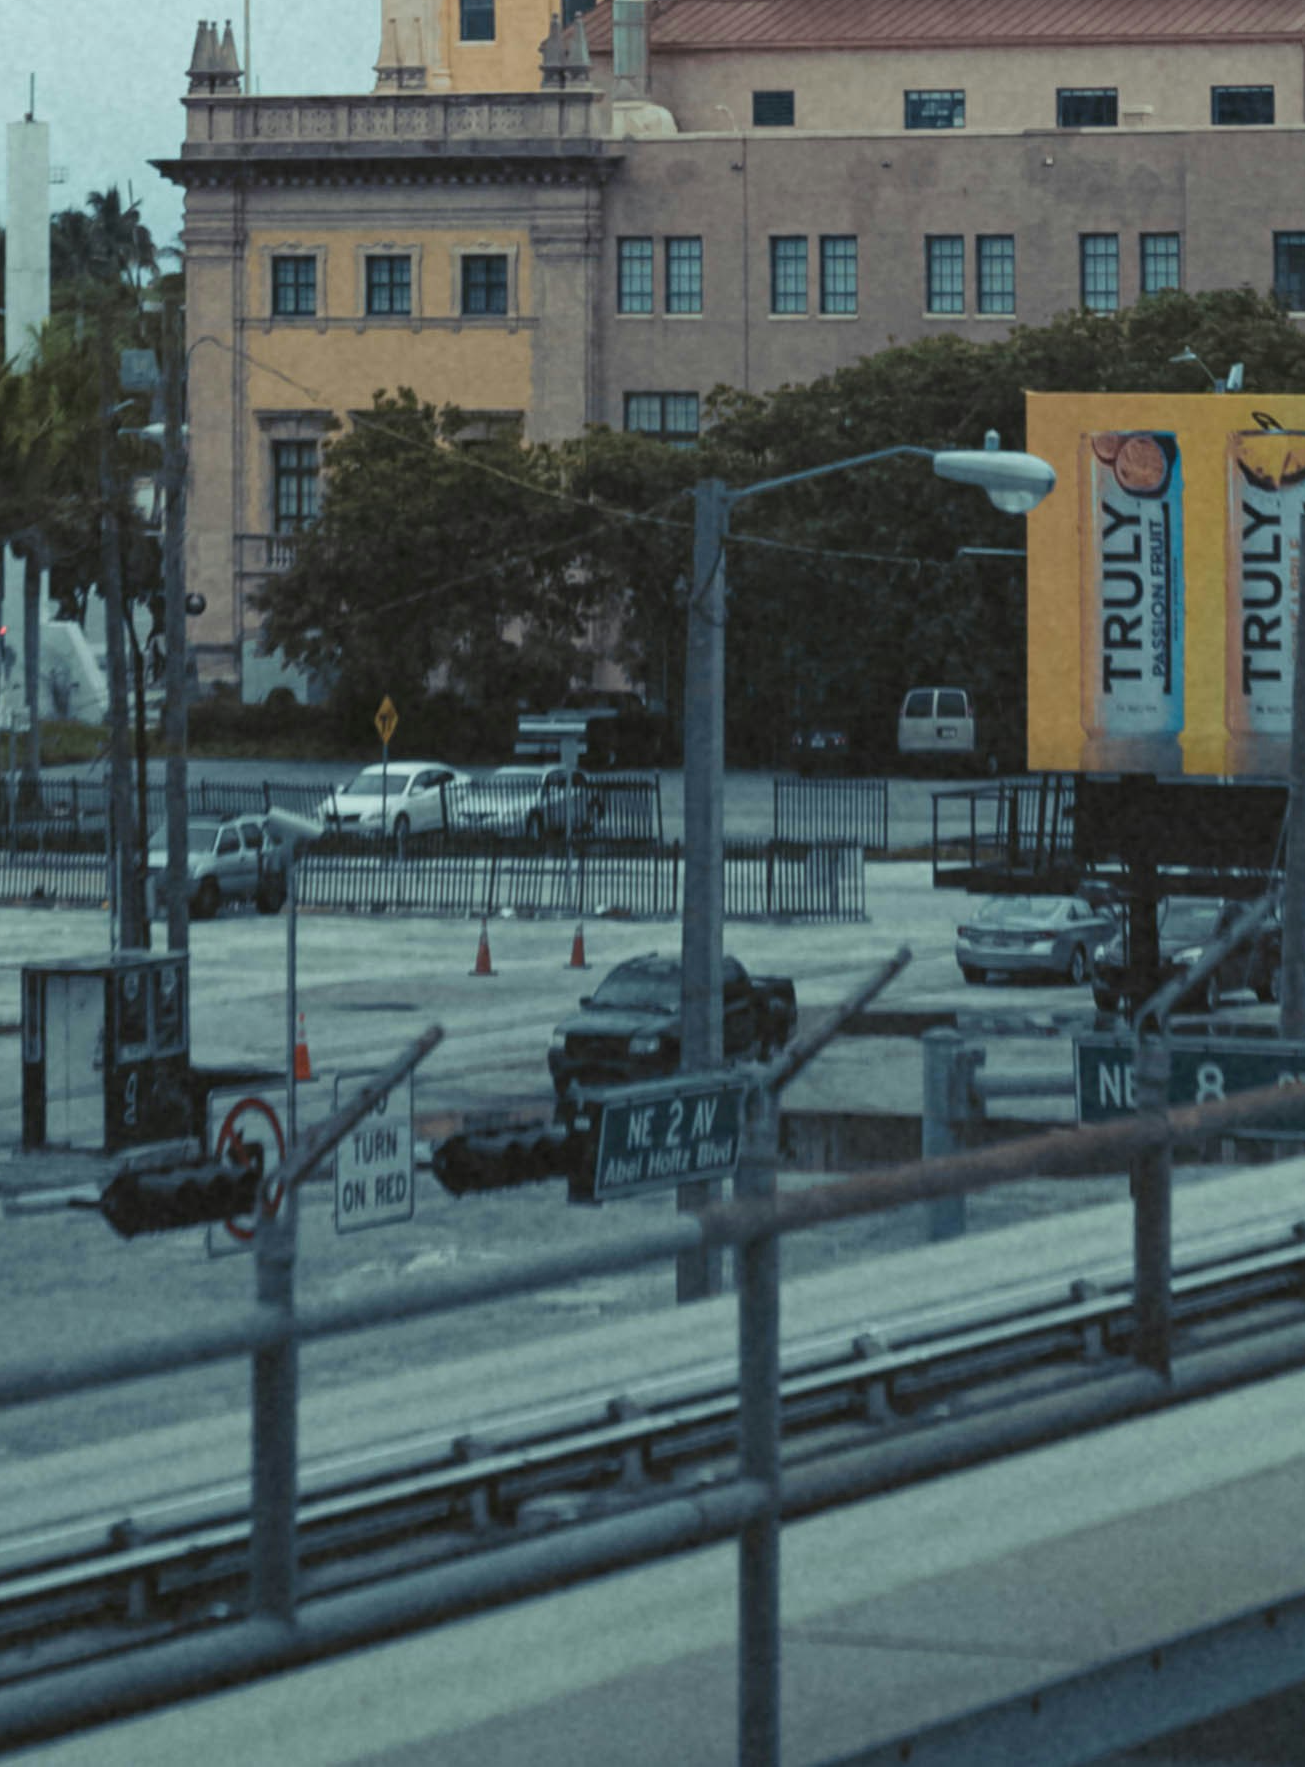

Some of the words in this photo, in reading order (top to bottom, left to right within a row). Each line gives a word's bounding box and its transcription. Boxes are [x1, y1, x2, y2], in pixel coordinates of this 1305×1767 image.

[1149, 519, 1164, 576] FRUIT
[1101, 501, 1144, 694] TRULY
[1241, 501, 1283, 695] TRULY
[1150, 584, 1165, 677] PASSION
[354, 1129, 397, 1165] TURN
[627, 1108, 655, 1151] NE
[666, 1098, 684, 1147] 2
[691, 1097, 718, 1139] AV
[605, 1153, 643, 1185] Abel
[697, 1138, 733, 1168] Blvd
[343, 1179, 366, 1213] ON
[375, 1174, 407, 1210] RED
